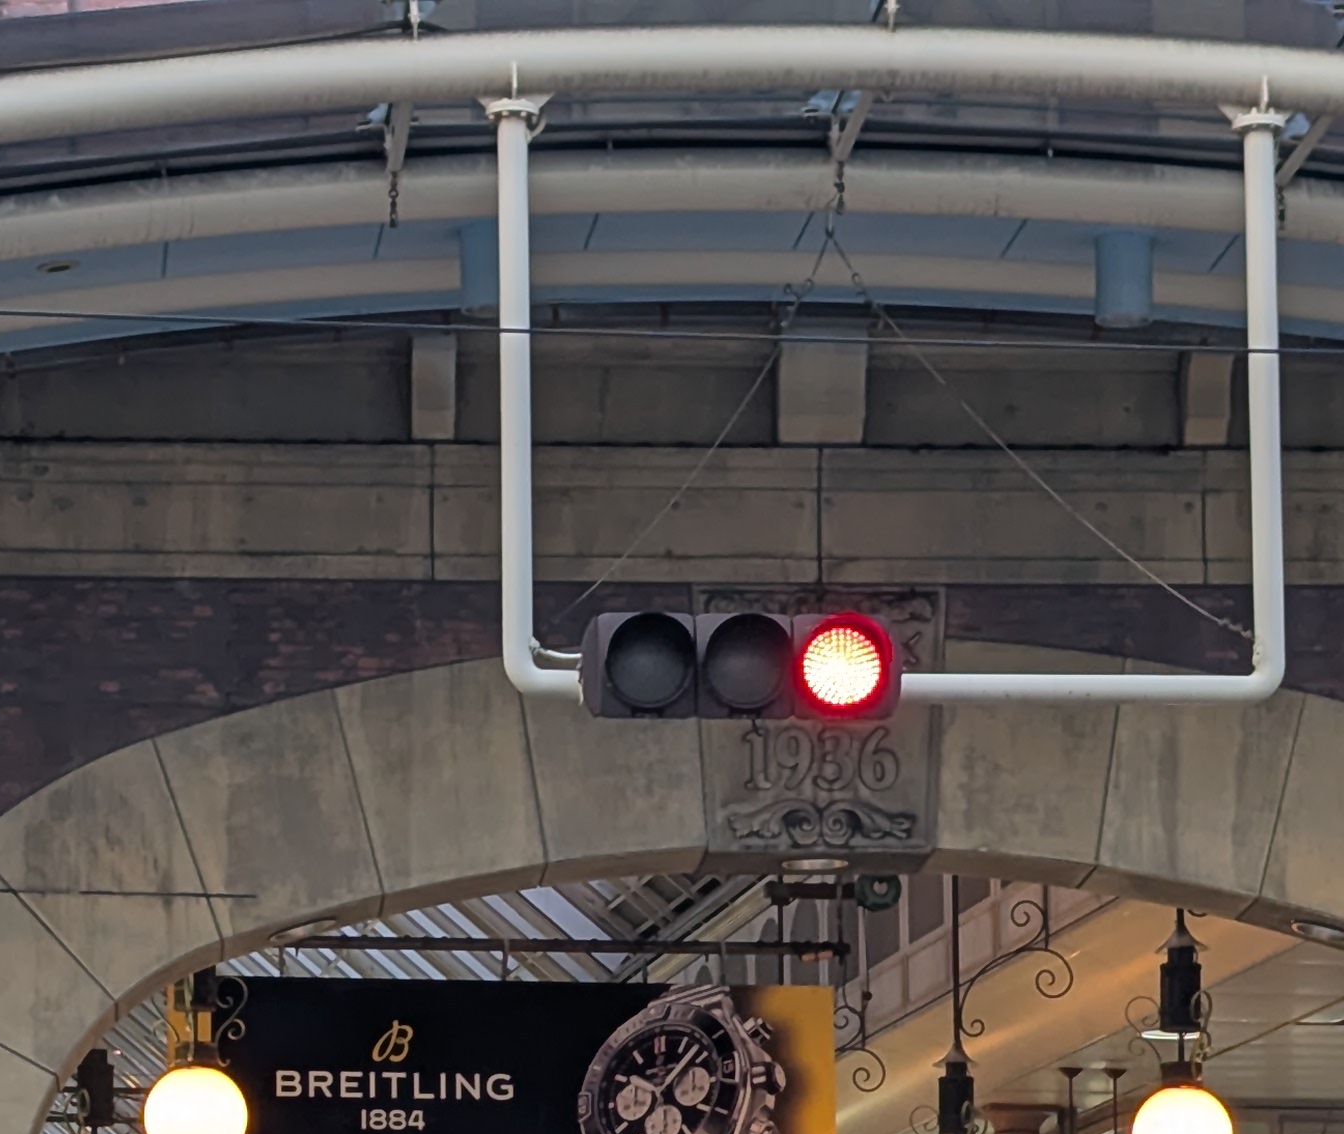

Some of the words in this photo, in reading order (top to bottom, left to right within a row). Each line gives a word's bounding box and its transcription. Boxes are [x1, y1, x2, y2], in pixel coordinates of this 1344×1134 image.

[743, 726, 899, 791] 1936
[275, 1070, 515, 1100] BREITLING
[360, 1109, 426, 1131] 1884
